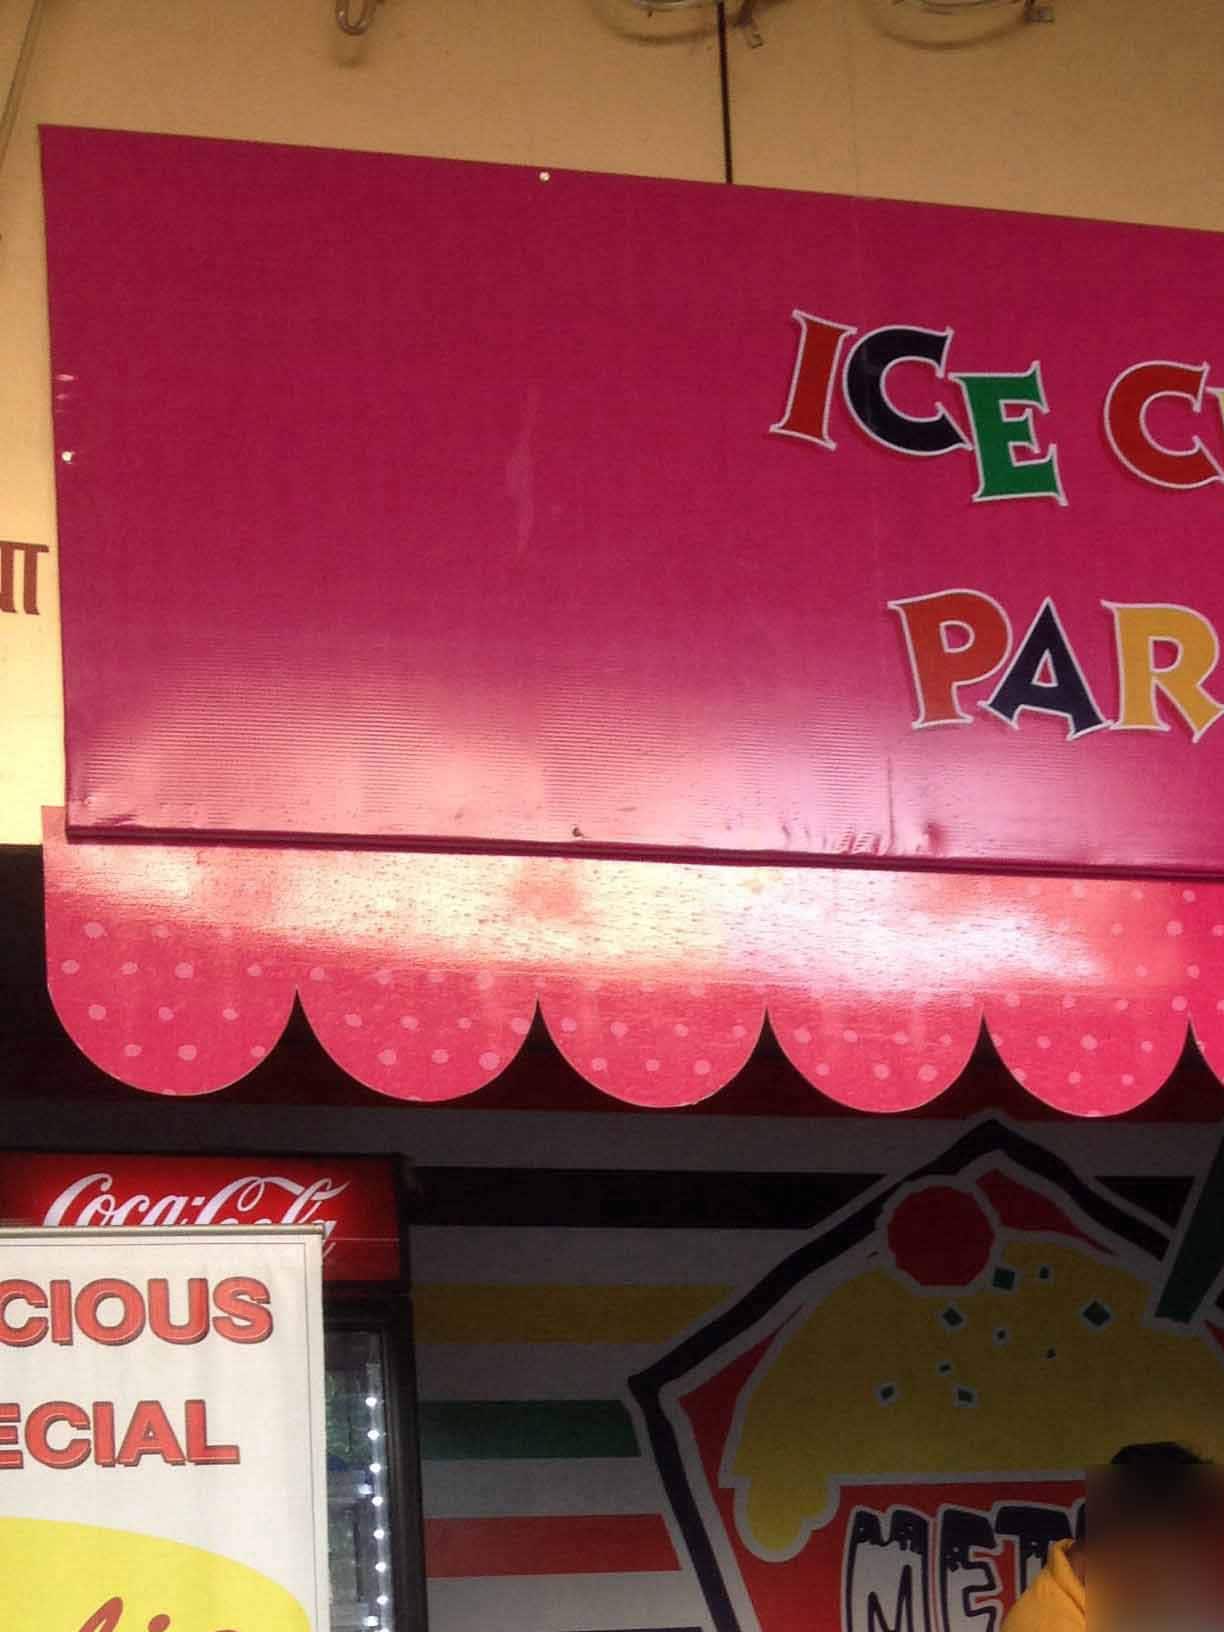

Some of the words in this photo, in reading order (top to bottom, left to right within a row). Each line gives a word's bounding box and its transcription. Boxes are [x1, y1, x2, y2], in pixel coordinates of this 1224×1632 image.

[770, 309, 1068, 506] ICE
[43, 1172, 350, 1257] Coca-Cl
[0, 1276, 274, 1348] CIOUS
